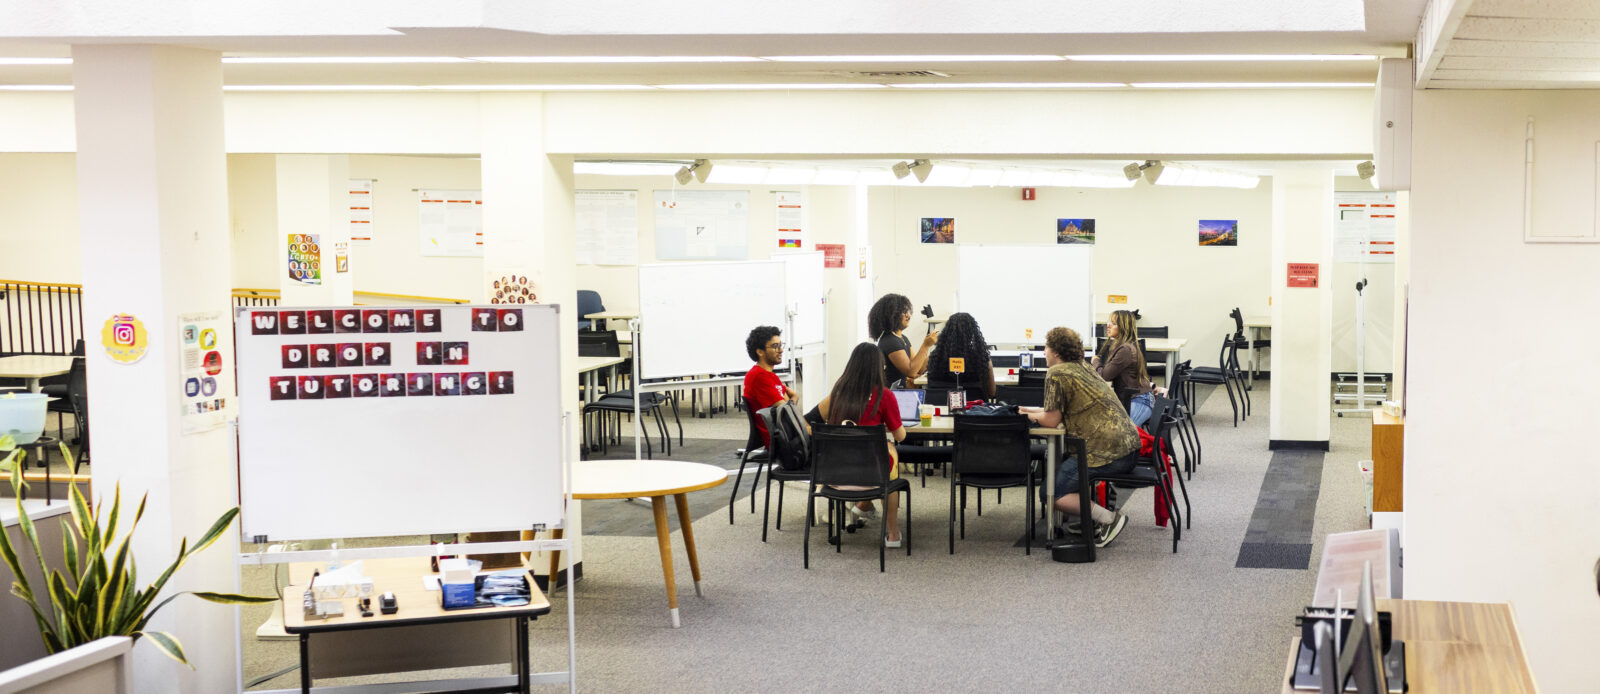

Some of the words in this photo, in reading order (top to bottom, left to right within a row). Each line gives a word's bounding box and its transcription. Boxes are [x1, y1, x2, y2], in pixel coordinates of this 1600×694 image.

[253, 313, 434, 330] WELCOME
[478, 312, 517, 326] TO
[288, 346, 385, 363] DROP
[425, 345, 463, 361] IN
[277, 375, 505, 394] TUTORING!
